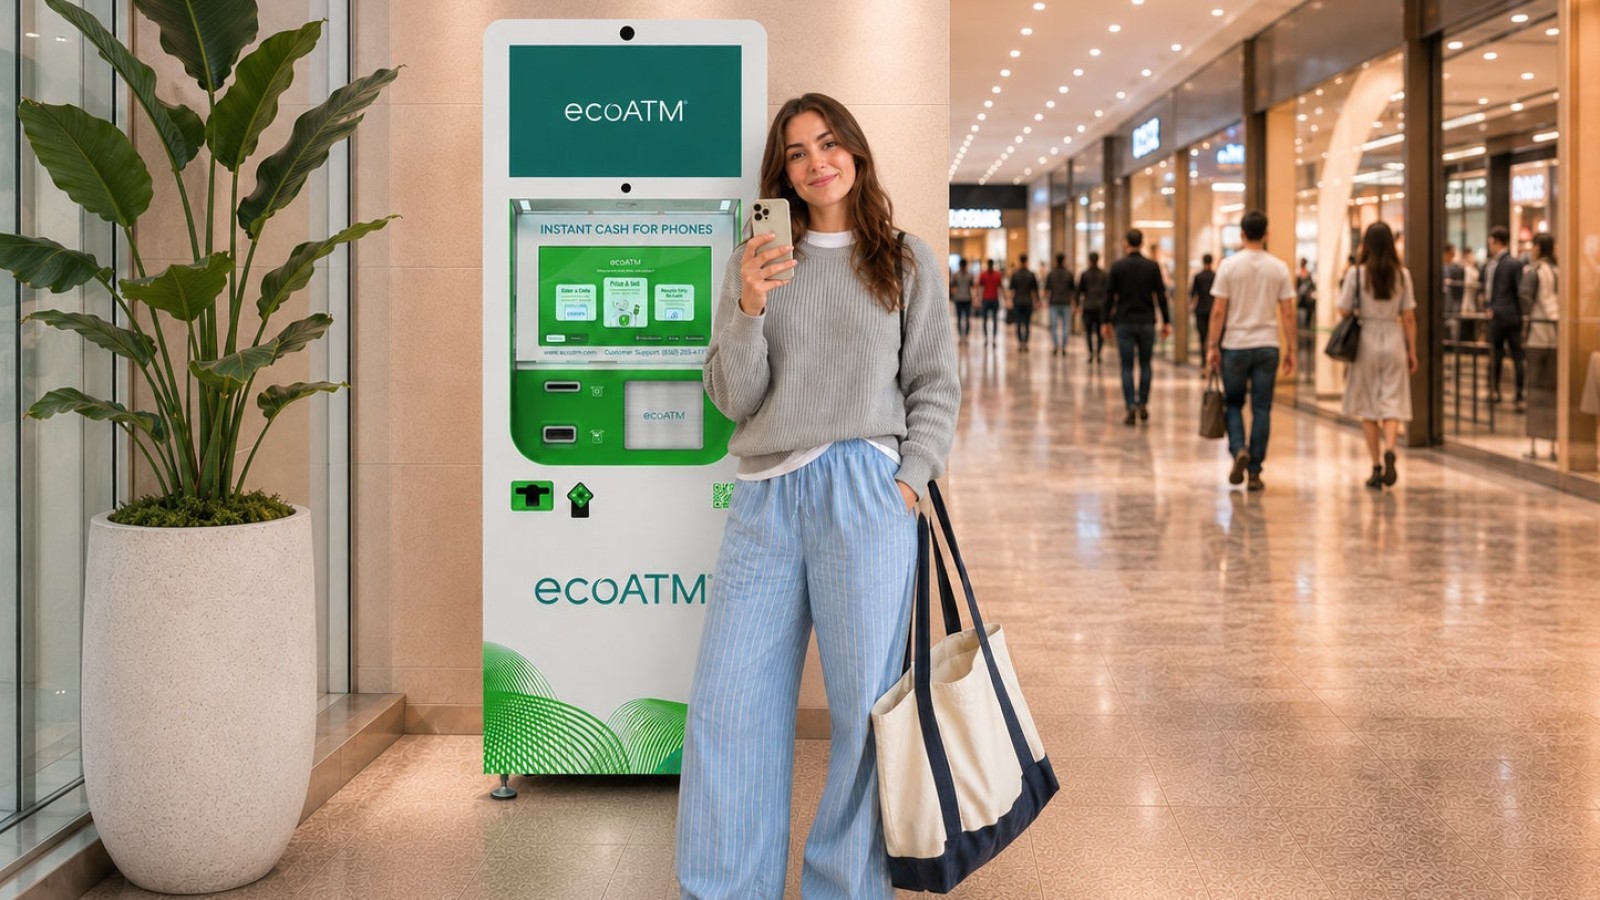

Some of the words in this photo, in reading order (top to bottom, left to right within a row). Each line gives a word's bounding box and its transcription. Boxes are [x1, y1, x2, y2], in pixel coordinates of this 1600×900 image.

[564, 100, 683, 122] ecoATM
[540, 224, 592, 235] INSTANT
[595, 224, 629, 235] CASH
[633, 224, 658, 235] FOR
[662, 224, 713, 235] PHONES
[643, 411, 685, 420] ecoATM
[534, 574, 706, 605] ecoATM
